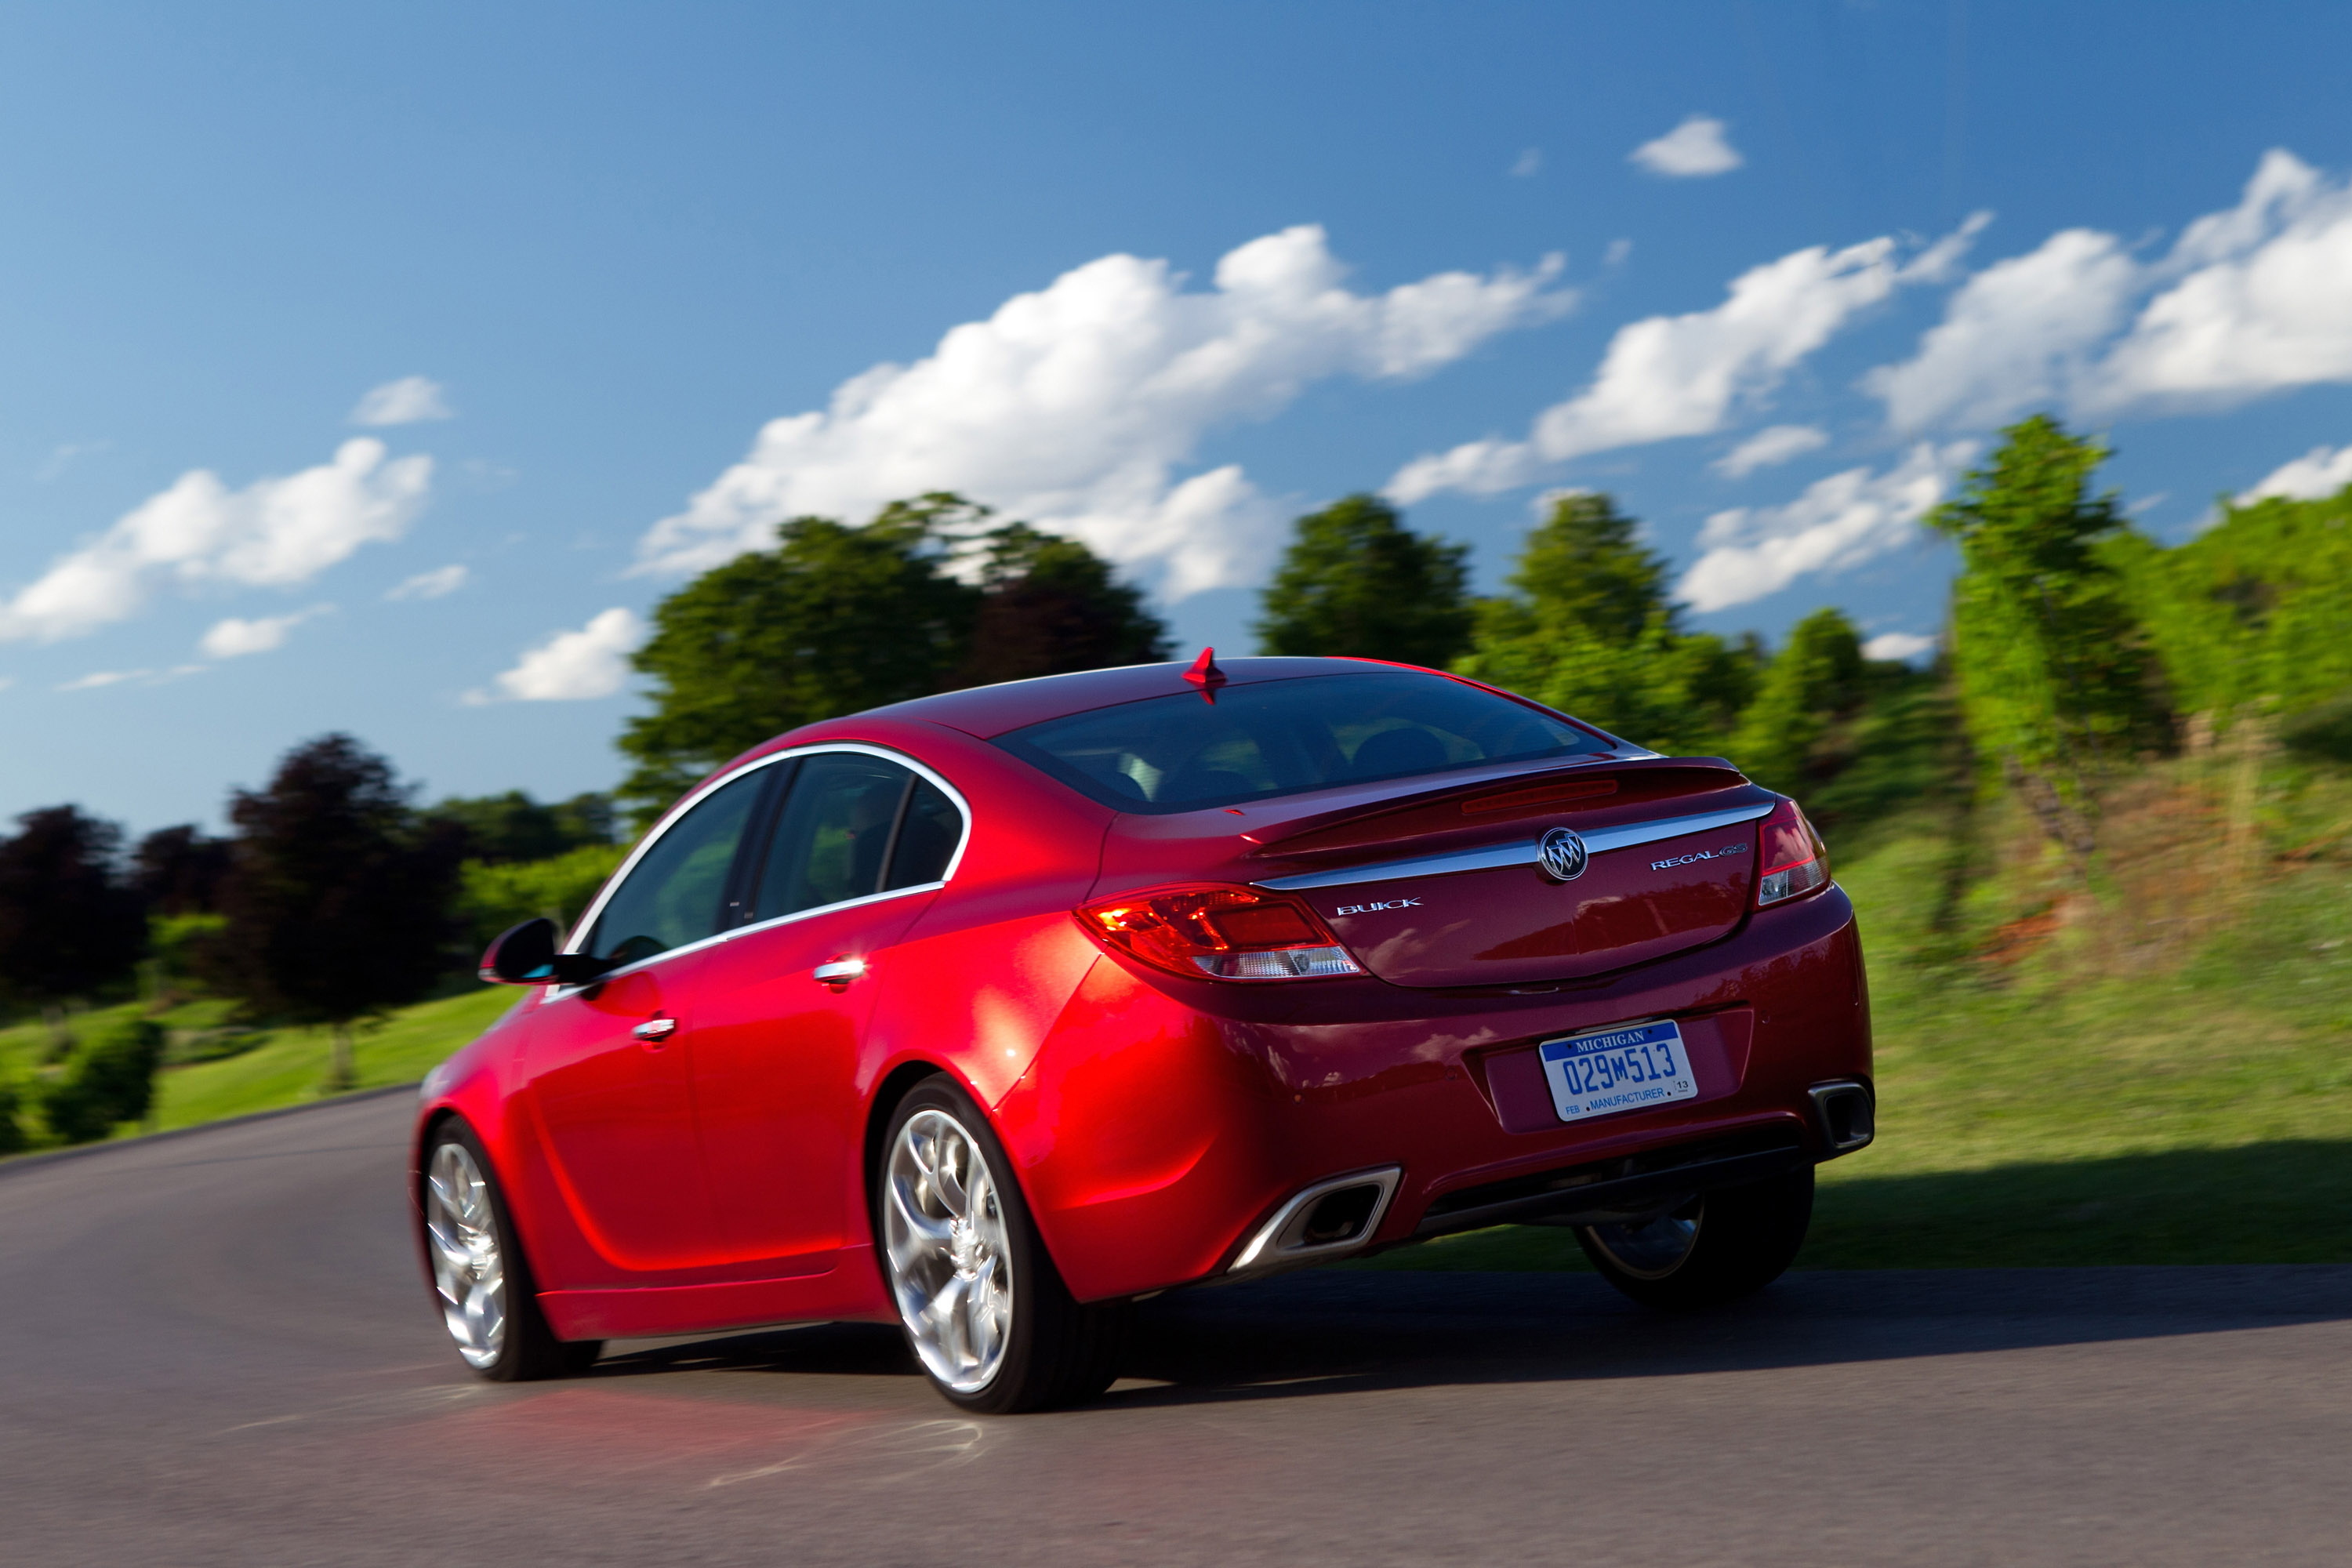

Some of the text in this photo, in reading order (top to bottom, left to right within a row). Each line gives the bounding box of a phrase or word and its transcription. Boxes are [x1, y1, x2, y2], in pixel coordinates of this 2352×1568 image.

[1650, 851, 1719, 870] REGAL
[1337, 896, 1424, 916] BUICK
[1576, 1031, 1645, 1053] MICHIGAN
[1563, 1043, 1676, 1095] 029M513
[1677, 1080, 1689, 1089] 13
[1590, 1087, 1665, 1110] MANUFACTURER
[1566, 1105, 1581, 1115] FEB
